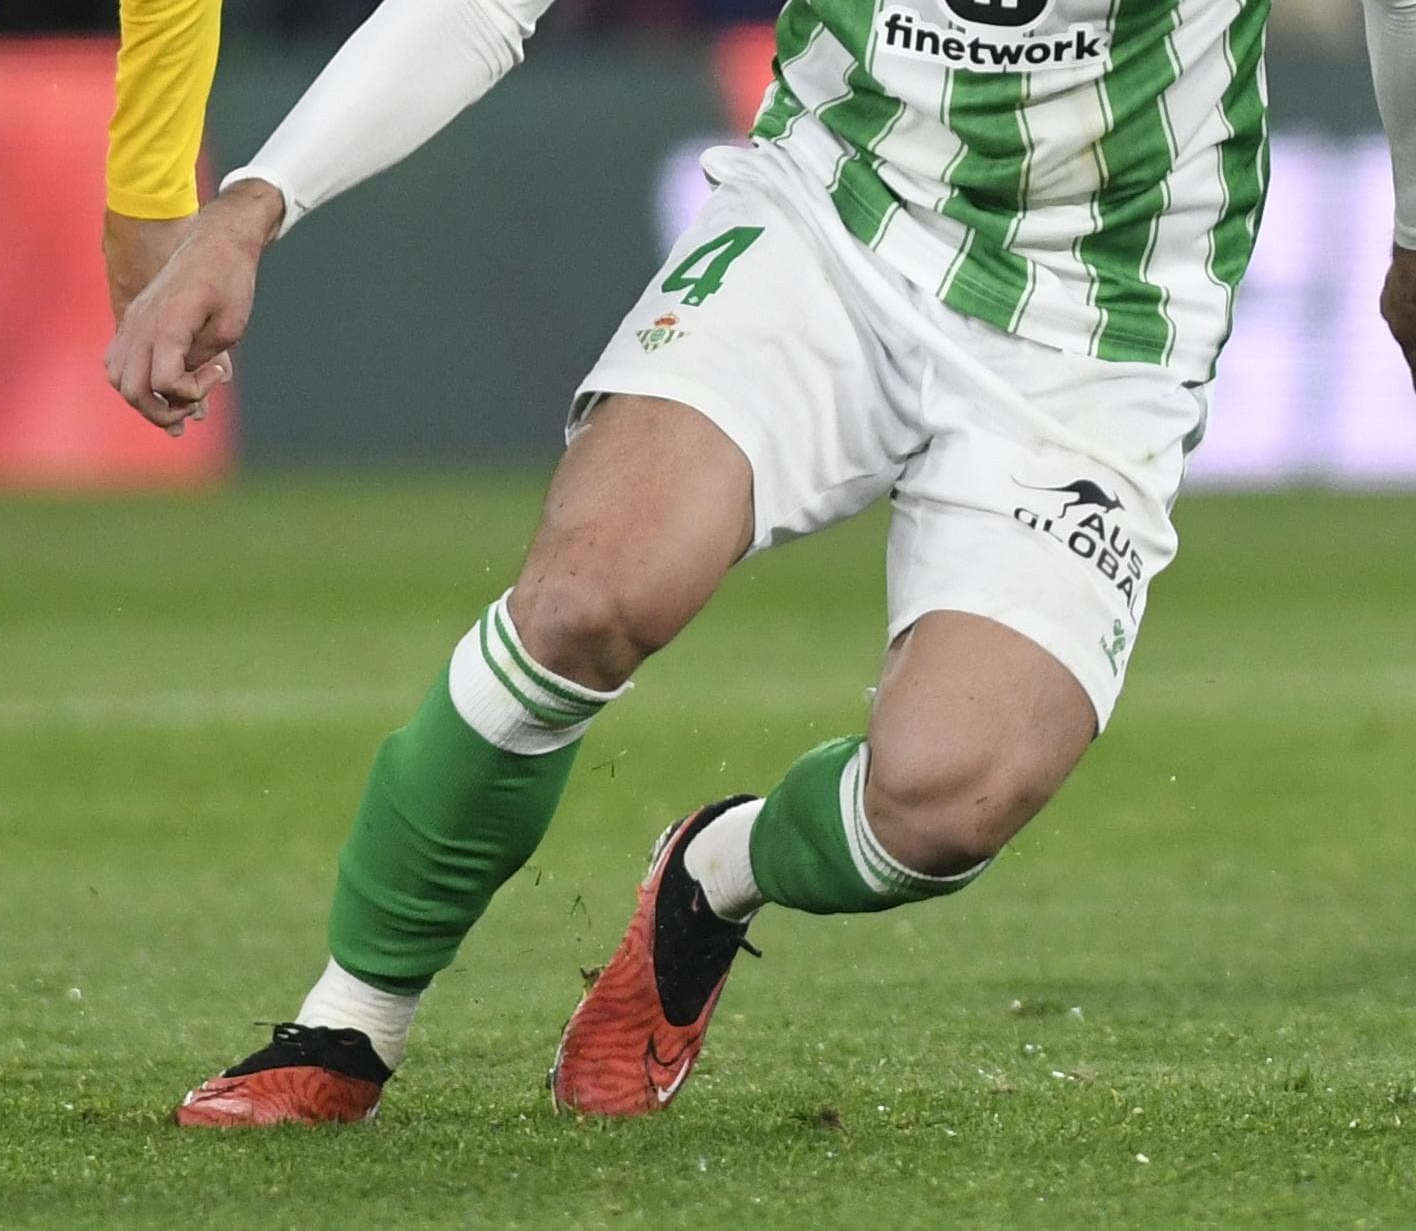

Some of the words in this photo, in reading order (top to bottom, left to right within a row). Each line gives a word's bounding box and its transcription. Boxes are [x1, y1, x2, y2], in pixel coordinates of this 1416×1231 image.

[885, 13, 1101, 66] finetwork
[661, 226, 766, 307] 4
[1076, 512, 1144, 581] AUS
